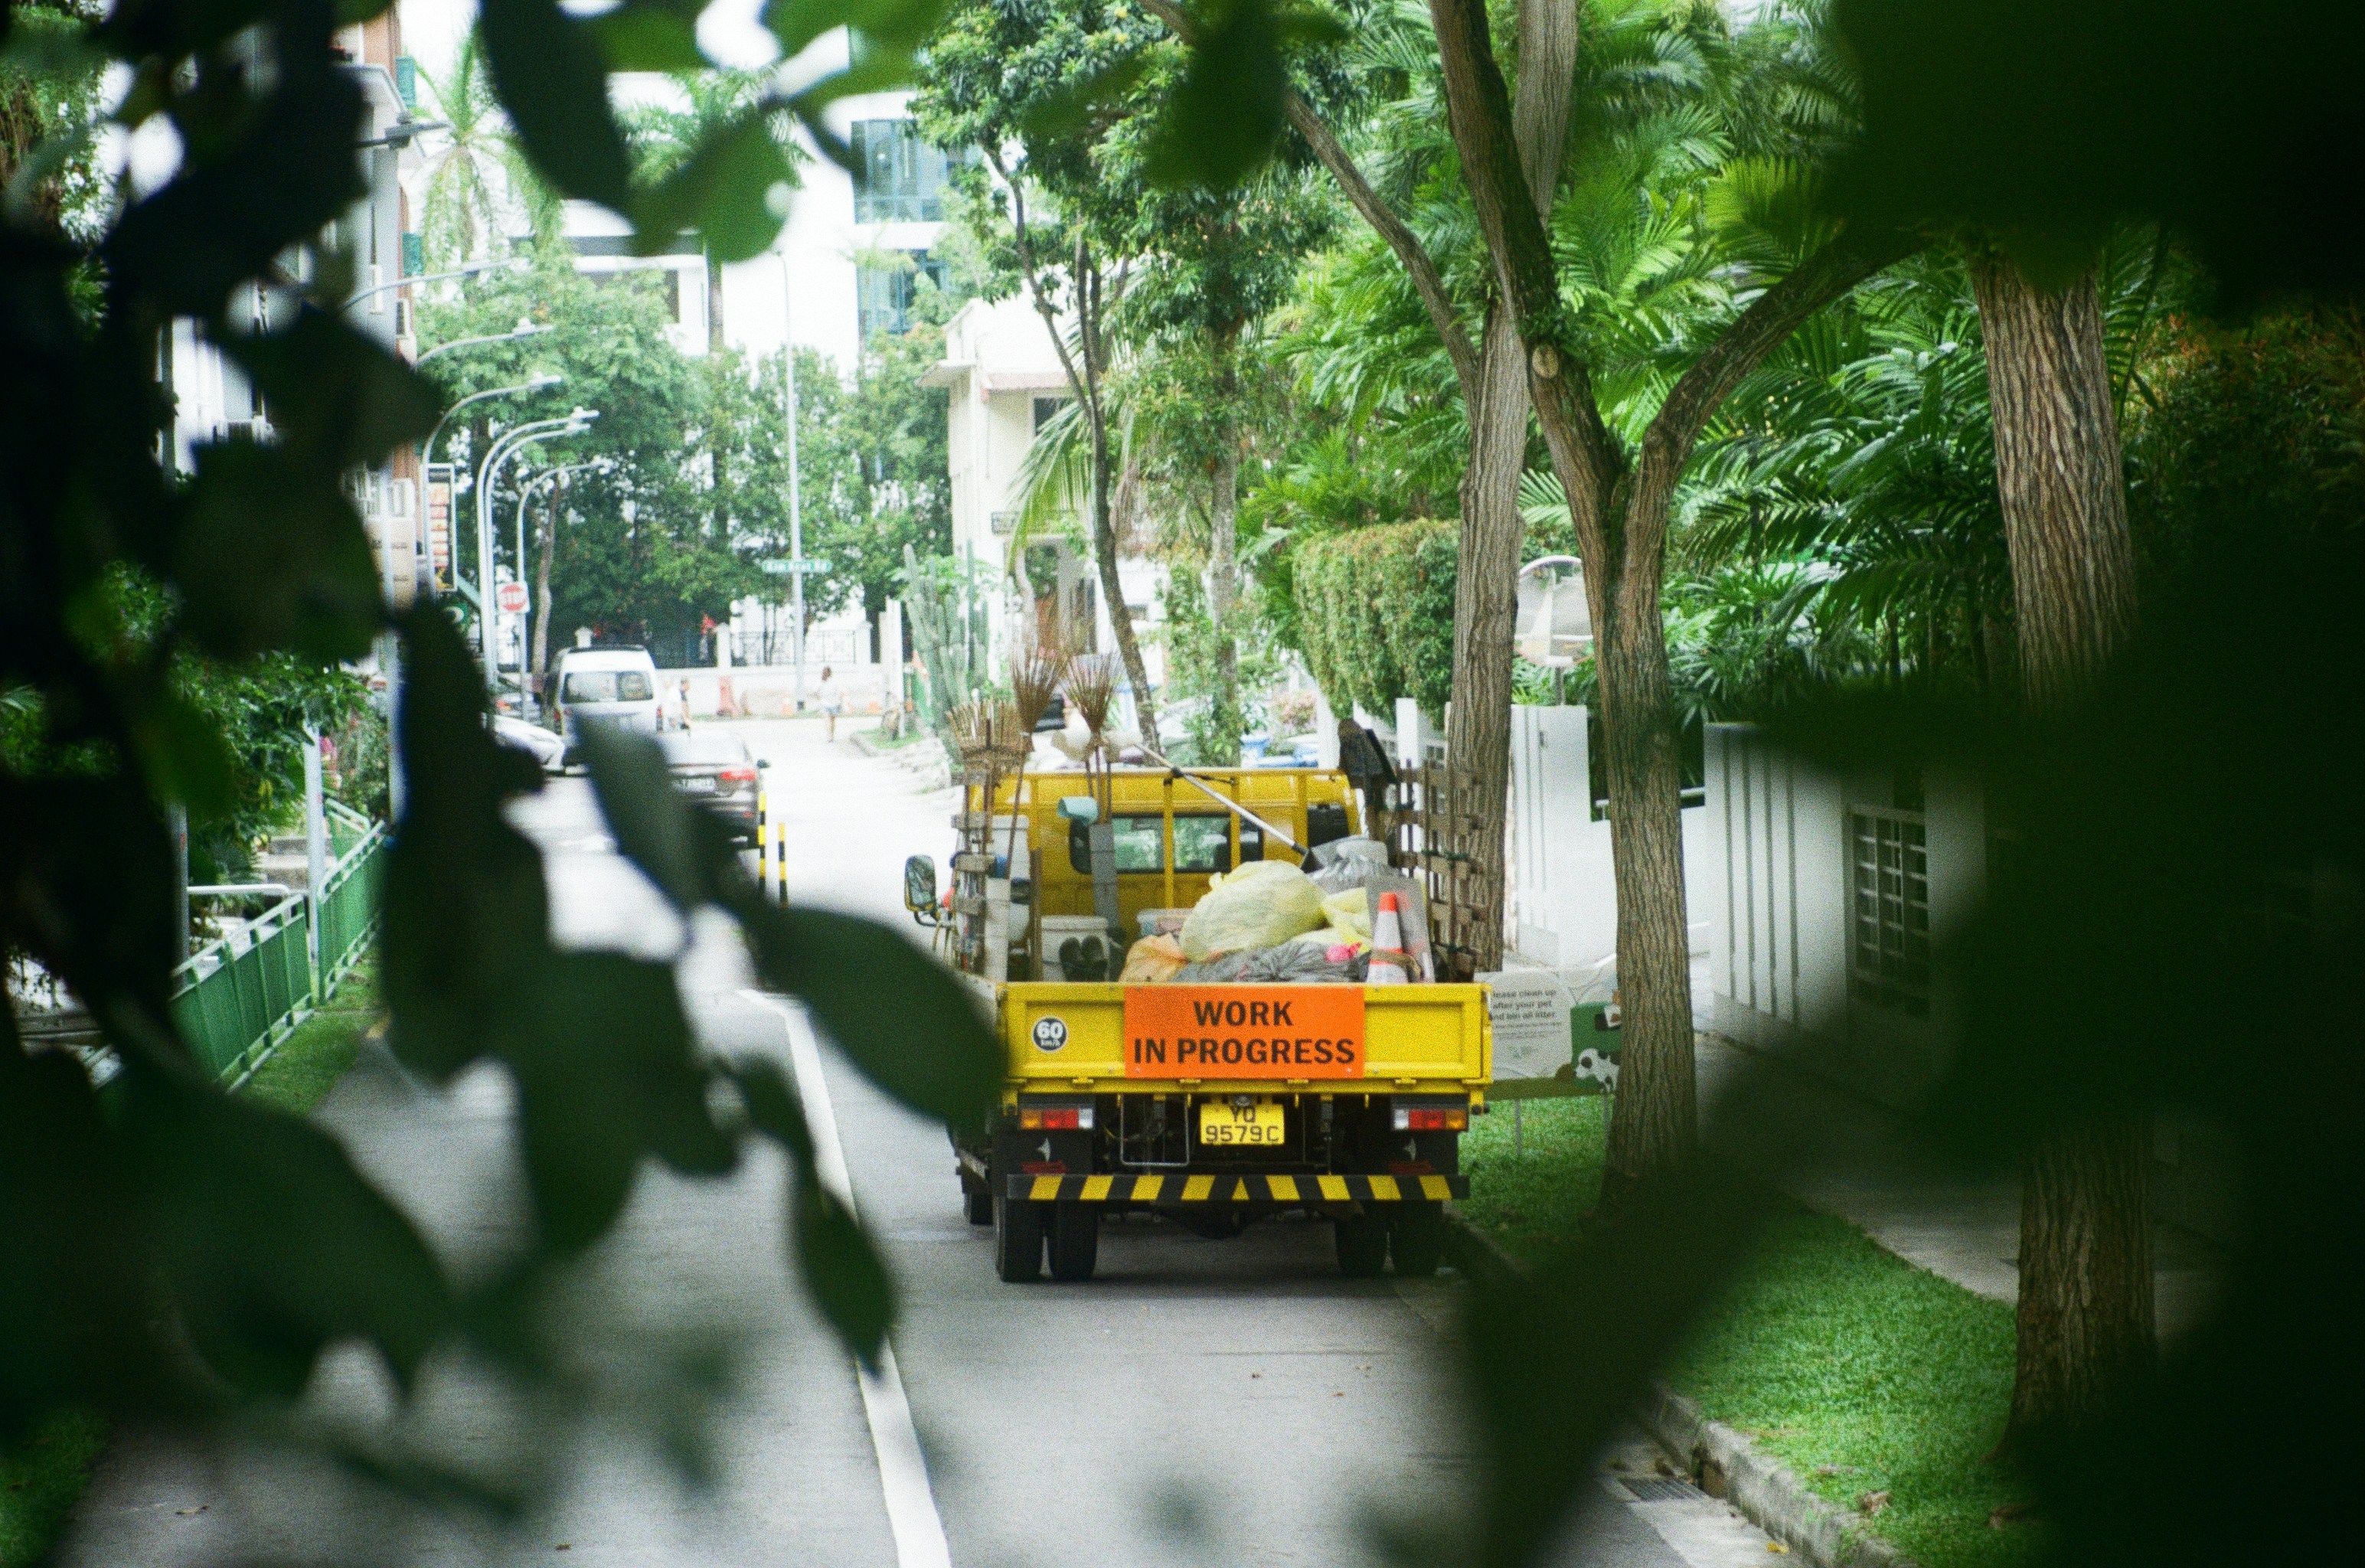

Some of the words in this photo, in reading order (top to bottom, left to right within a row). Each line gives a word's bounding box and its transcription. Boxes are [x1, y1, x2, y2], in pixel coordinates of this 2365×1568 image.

[1545, 989, 1557, 998] up
[1193, 1001, 1294, 1026] WORK
[1516, 1001, 1535, 1011] your
[1537, 1000, 1553, 1009] pet
[1037, 1021, 1063, 1039] 60
[1133, 1038, 1166, 1064] IN
[1177, 1037, 1355, 1065] PROGRESS
[1230, 1106, 1256, 1123] YQ
[1205, 1125, 1279, 1142] 9579C
